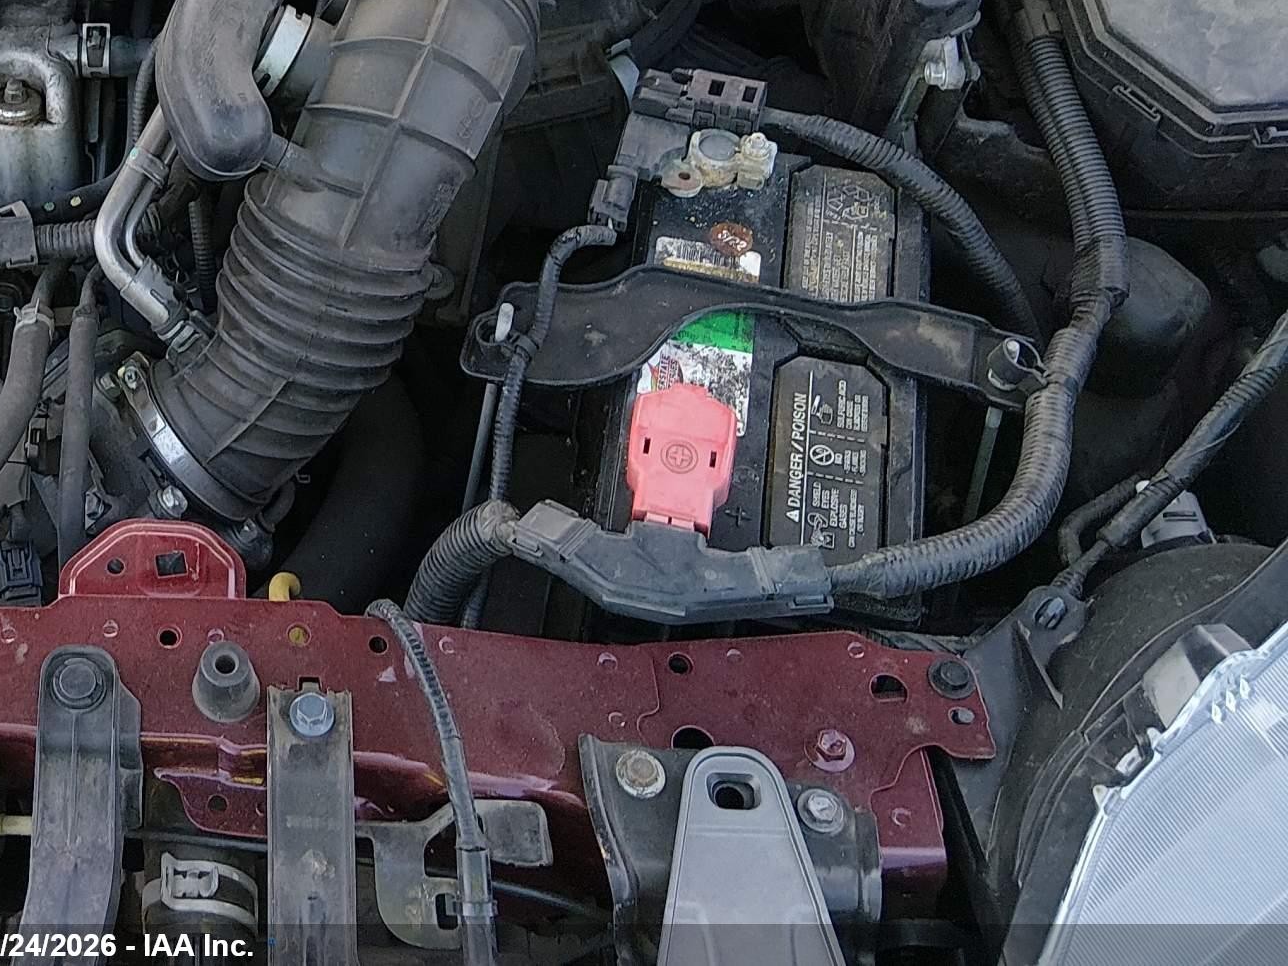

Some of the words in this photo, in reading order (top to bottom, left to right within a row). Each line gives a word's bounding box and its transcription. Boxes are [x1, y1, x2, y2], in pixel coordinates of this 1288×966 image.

[657, 354, 670, 391] ERSTATE
[792, 392, 807, 441] POISON
[787, 452, 804, 508] DANGER
[812, 481, 821, 508] SHIELD
